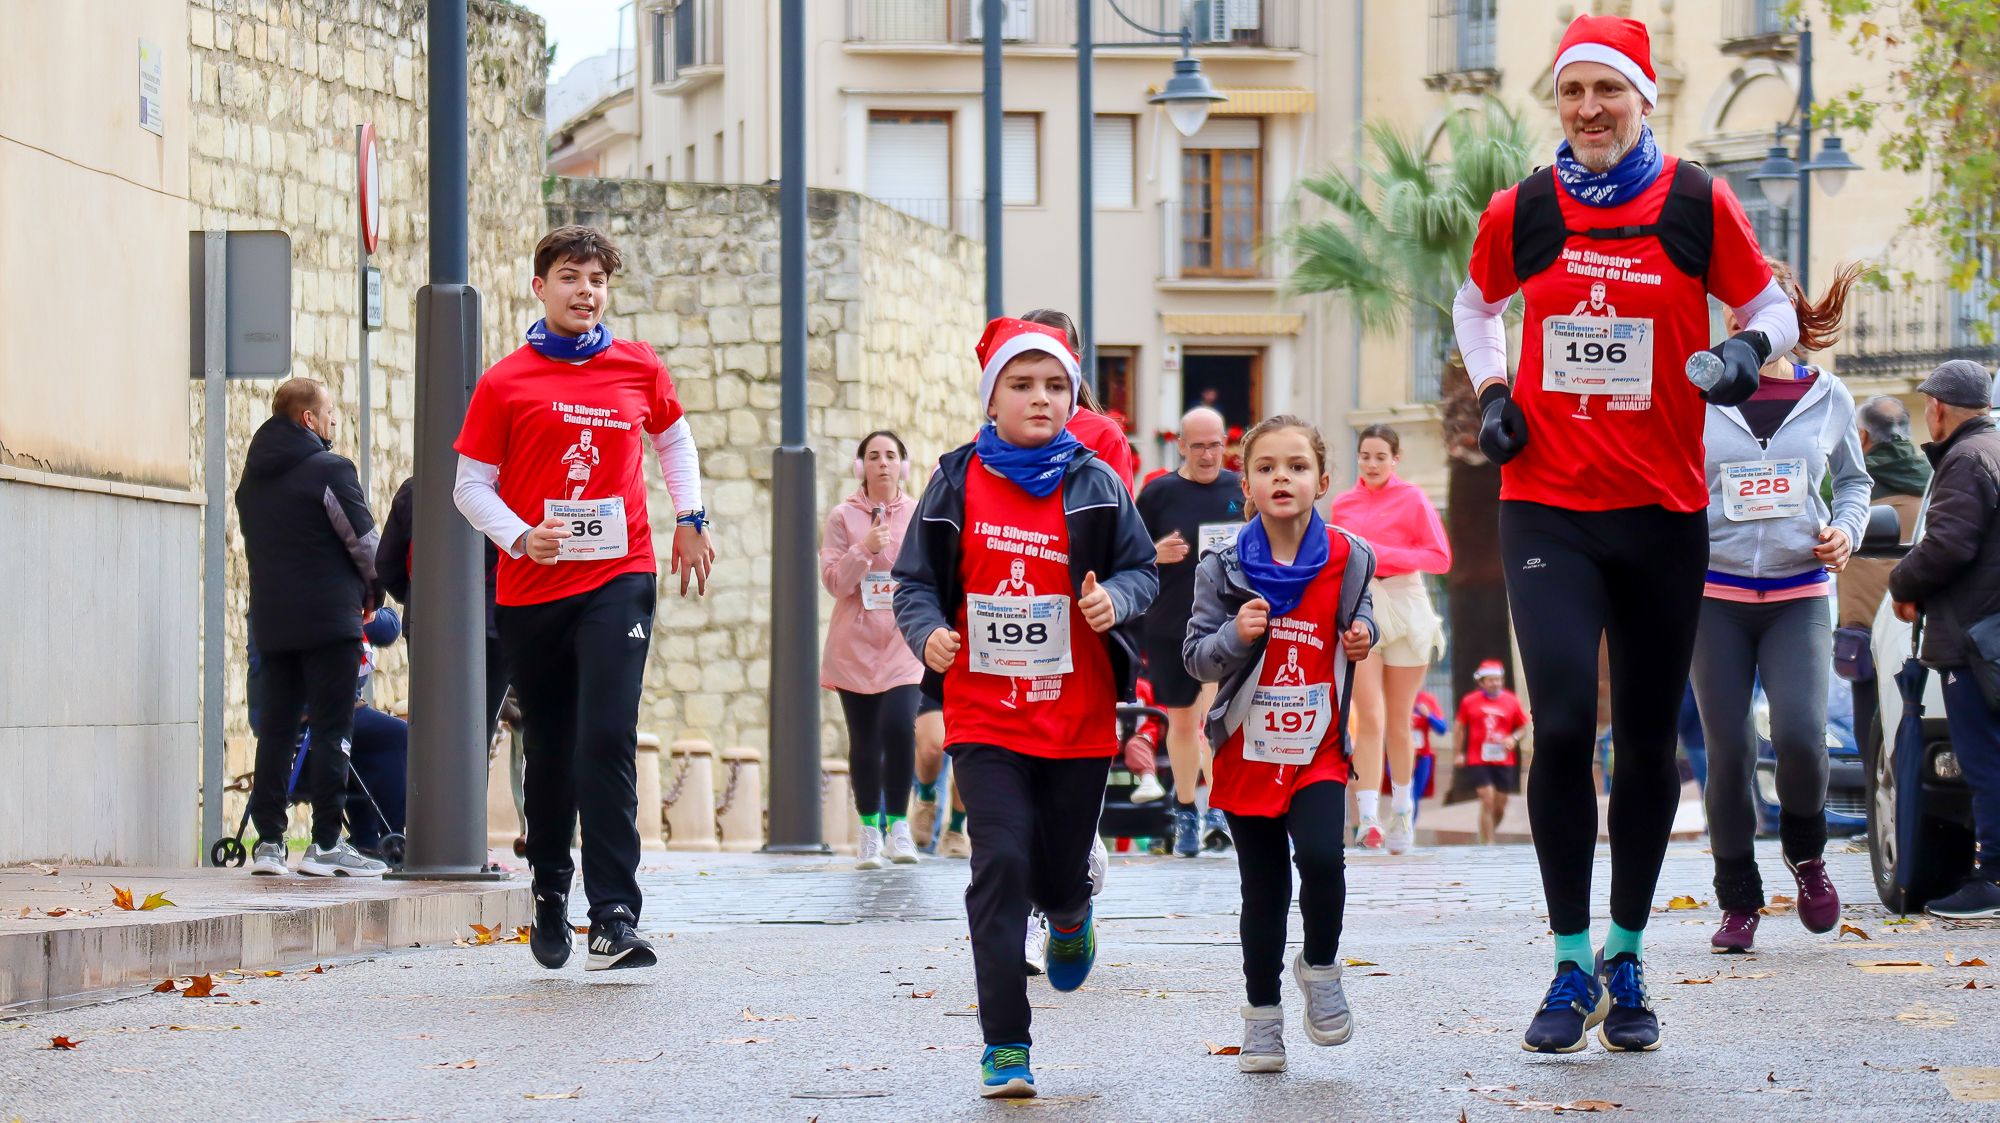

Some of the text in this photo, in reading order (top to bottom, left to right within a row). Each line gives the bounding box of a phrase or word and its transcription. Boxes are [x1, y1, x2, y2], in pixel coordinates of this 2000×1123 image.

[1562, 248, 1631, 268] San Silvestre
[1566, 261, 1661, 286] Ciudad de Lucena
[1554, 330, 1574, 338] Ciudad
[1565, 341, 1627, 364] 196
[552, 402, 557, 411] I
[558, 402, 573, 413] San
[574, 404, 611, 417] Silvestre
[1606, 401, 1652, 412] MARJALIZO
[563, 413, 632, 431] Ciudad de Lucena
[1740, 478, 1790, 496] 228
[571, 520, 603, 537] 36
[974, 521, 981, 534] I
[981, 522, 1001, 537] San
[1002, 525, 1049, 545] Silvestre
[986, 537, 1070, 566] Ciudad de Lucen
[986, 622, 1048, 645] 198
[1269, 617, 1315, 632] an Silvestre
[1271, 628, 1297, 642] Ciudad
[1297, 631, 1307, 643] de
[1265, 709, 1317, 733] 197
